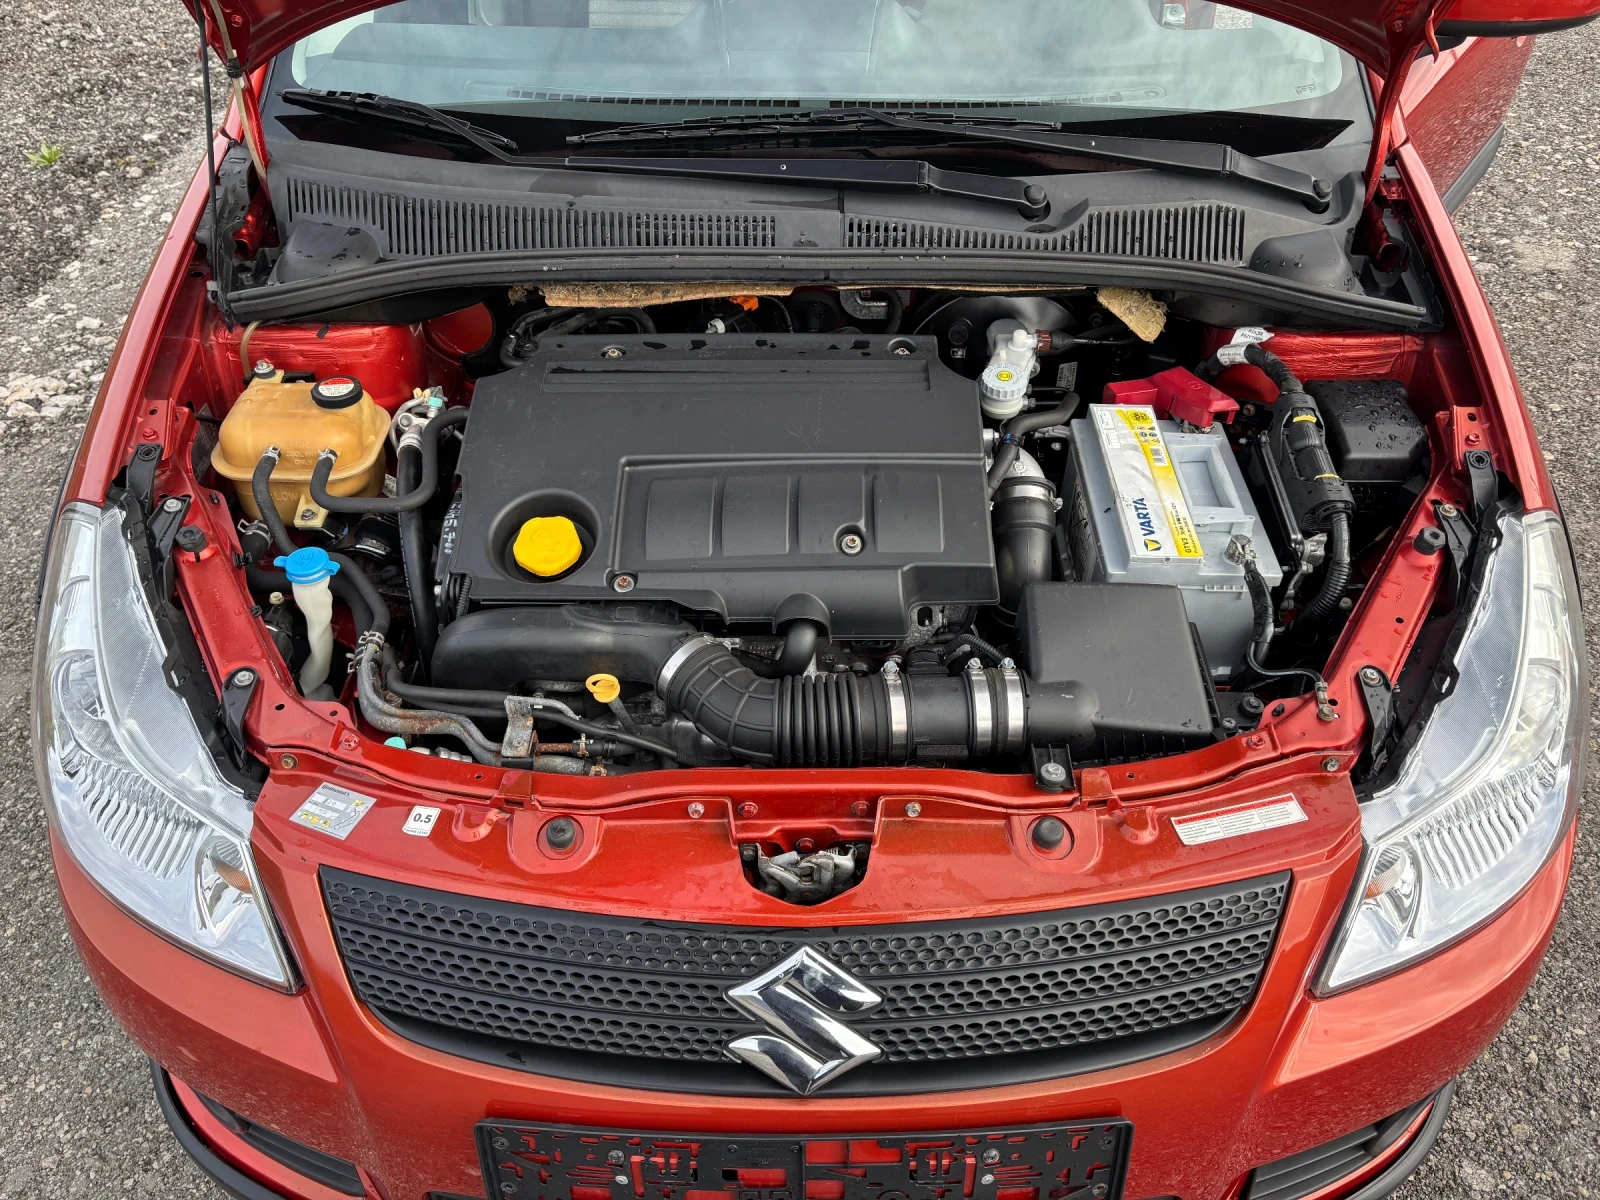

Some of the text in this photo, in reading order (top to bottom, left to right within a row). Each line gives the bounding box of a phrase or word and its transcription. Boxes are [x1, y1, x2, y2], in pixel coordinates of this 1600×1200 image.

[273, 492, 298, 501] LOW
[1132, 497, 1156, 536] VARTA
[413, 812, 433, 824] 0.5
